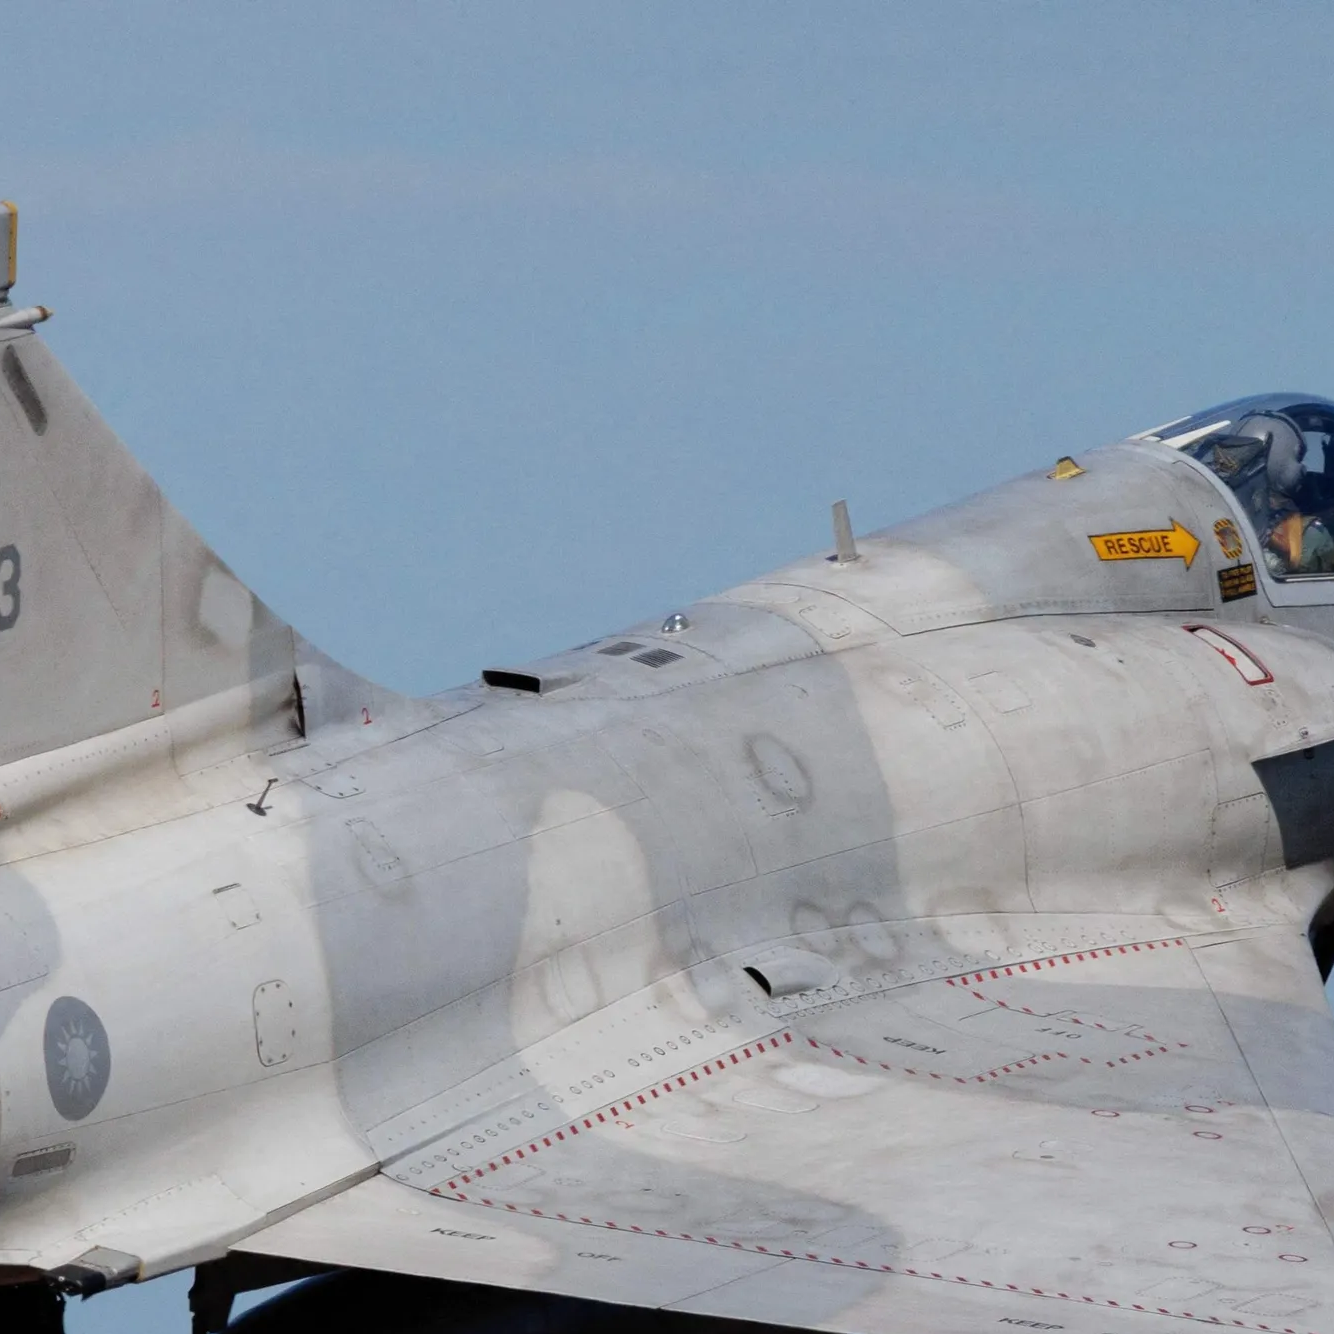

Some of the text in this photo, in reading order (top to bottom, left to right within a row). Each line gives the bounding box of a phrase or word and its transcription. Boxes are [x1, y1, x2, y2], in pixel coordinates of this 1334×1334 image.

[1103, 535, 1174, 556] RESCUE
[1034, 1027, 1082, 1040] OFF
[882, 1035, 948, 1055] KEEP
[429, 1227, 623, 1262] KEEP OFF
[998, 1317, 1065, 1331] KEEP
